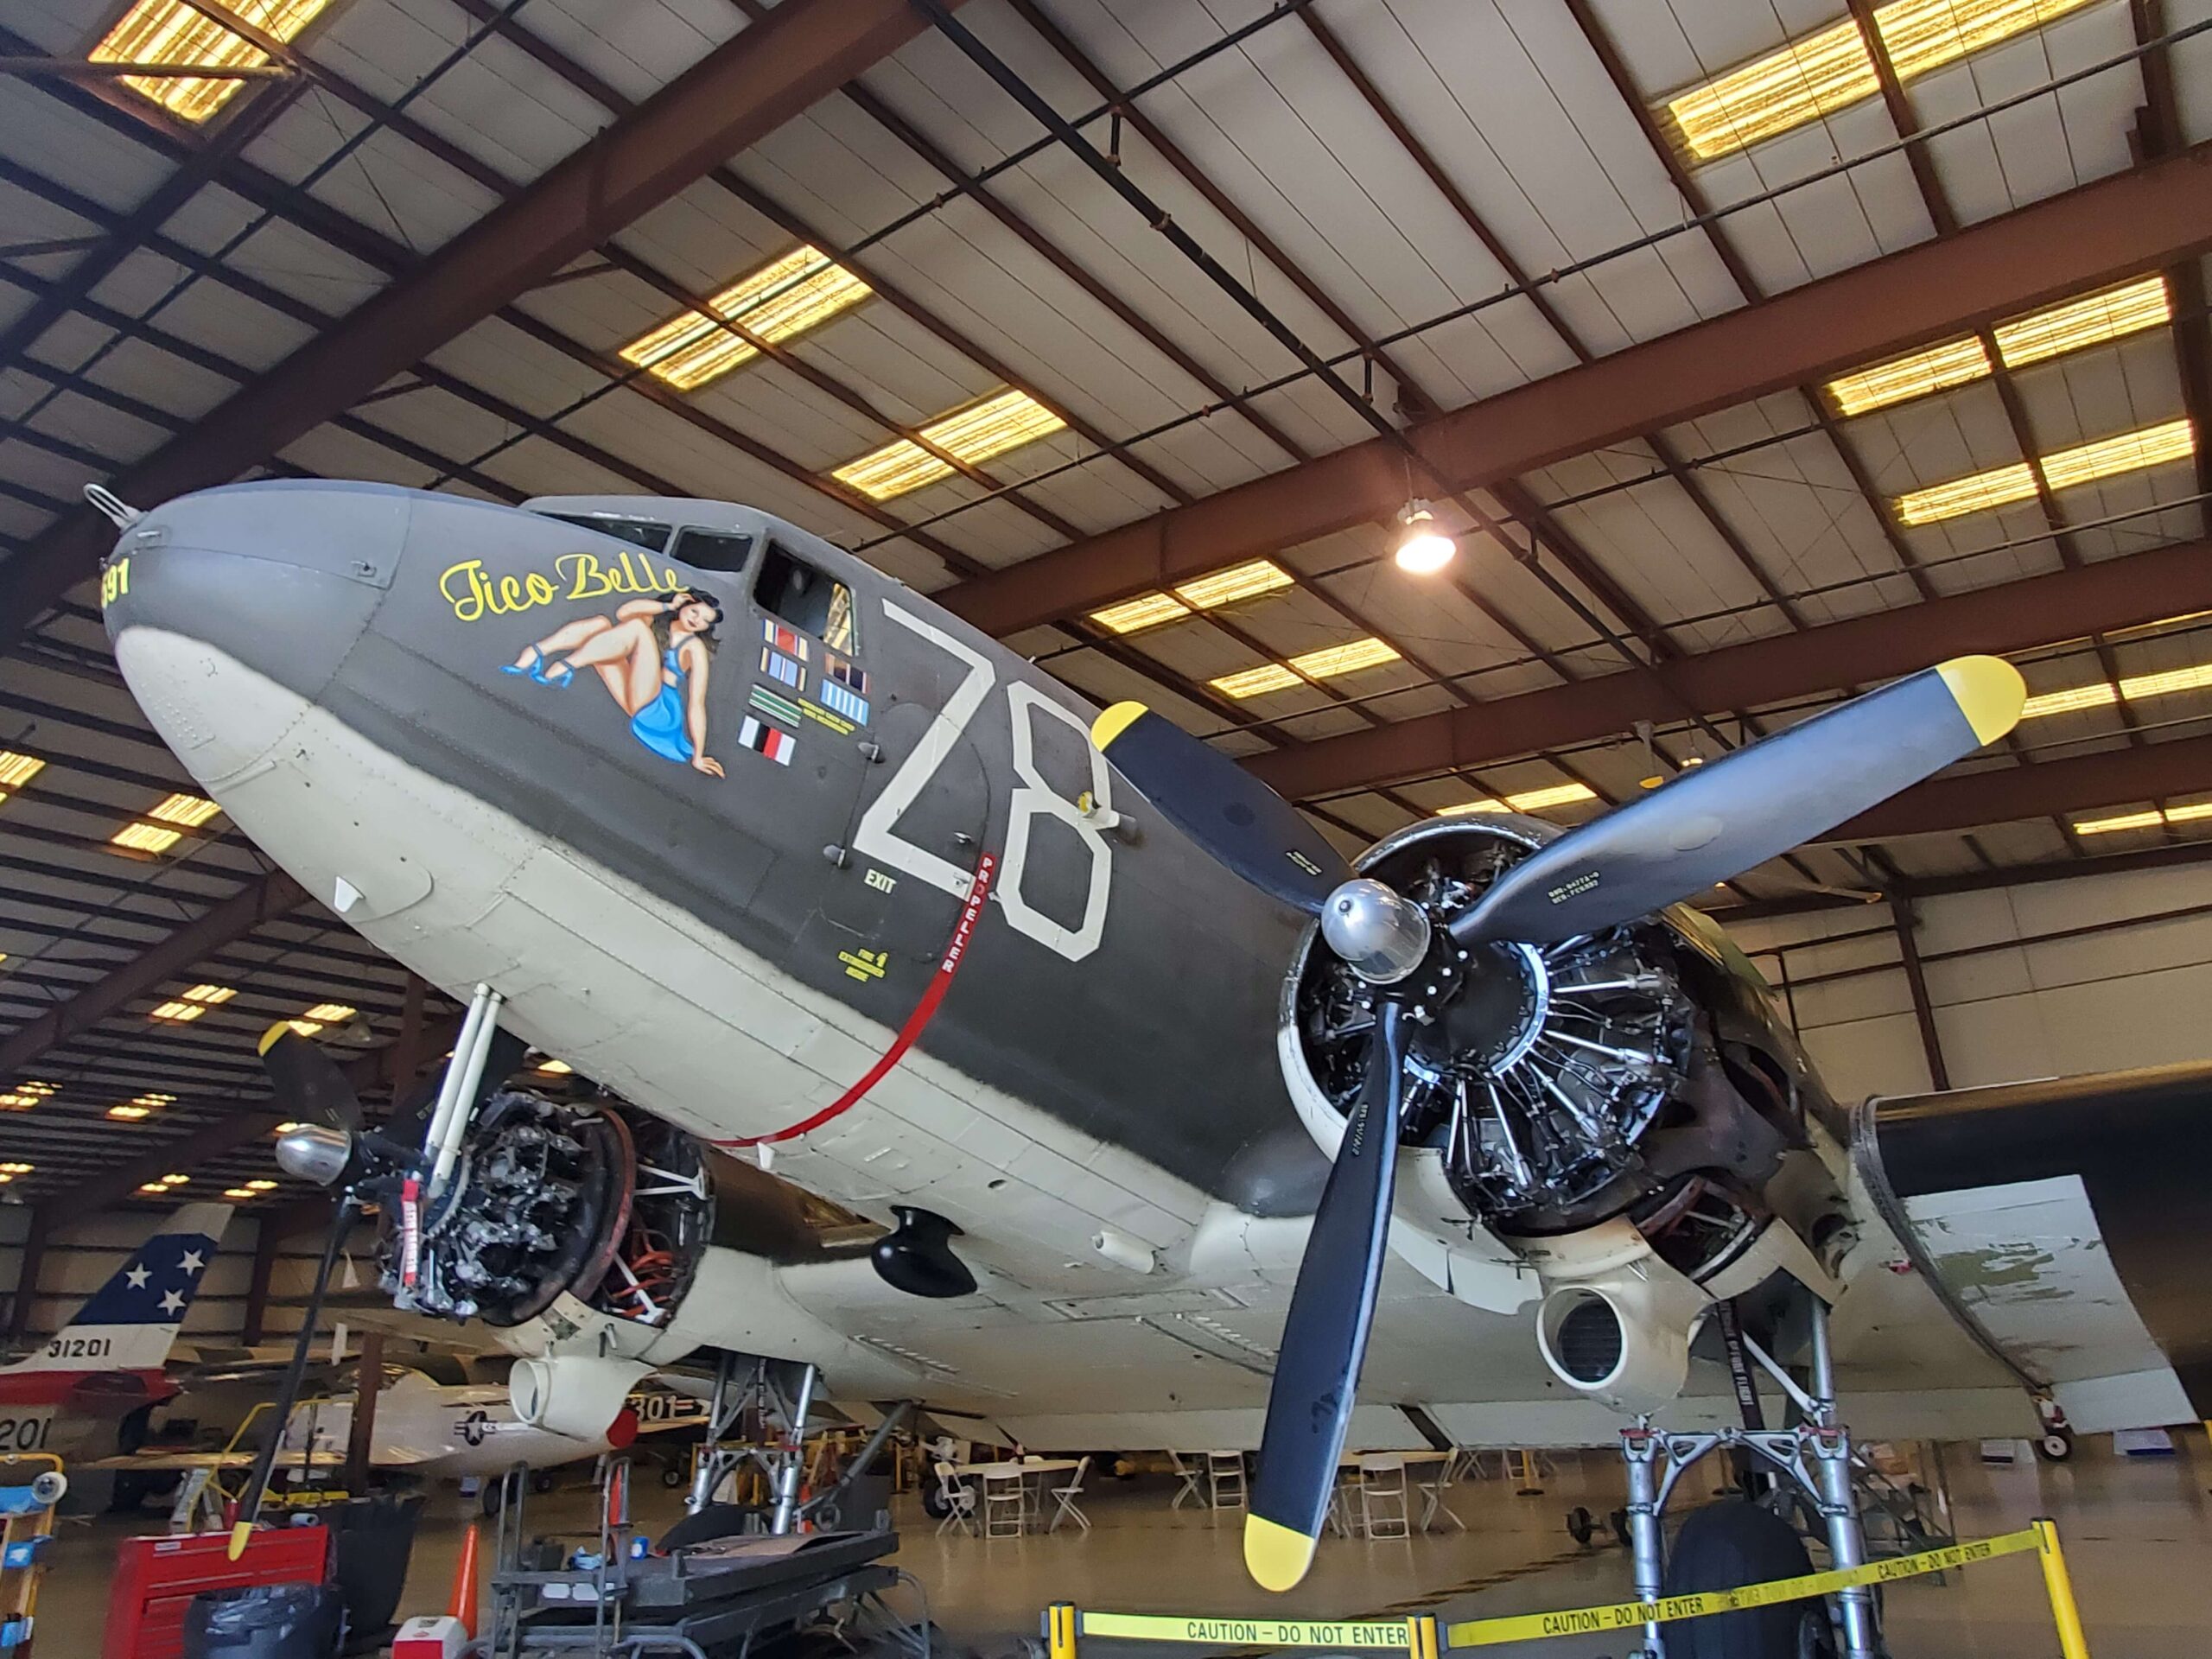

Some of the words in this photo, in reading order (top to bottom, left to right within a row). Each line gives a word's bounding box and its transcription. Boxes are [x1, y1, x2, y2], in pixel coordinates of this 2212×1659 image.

[439, 559, 560, 621] Tico
[555, 551, 690, 600] Belle
[864, 868, 897, 893] EXIT
[941, 856, 994, 973] PROPELLER
[48, 1338, 111, 1358] 31201
[0, 1418, 52, 1451] 201
[1543, 1611, 1600, 1635] CAUTION
[1614, 1607, 1633, 1625] DO
[1637, 1604, 1662, 1622] NOT
[1667, 1596, 1705, 1618] ENTER
[1187, 1622, 1257, 1642] CAUTION
[1278, 1624, 1301, 1643] DO
[1310, 1625, 1344, 1643] NOT
[1353, 1626, 1408, 1645] ENTER
